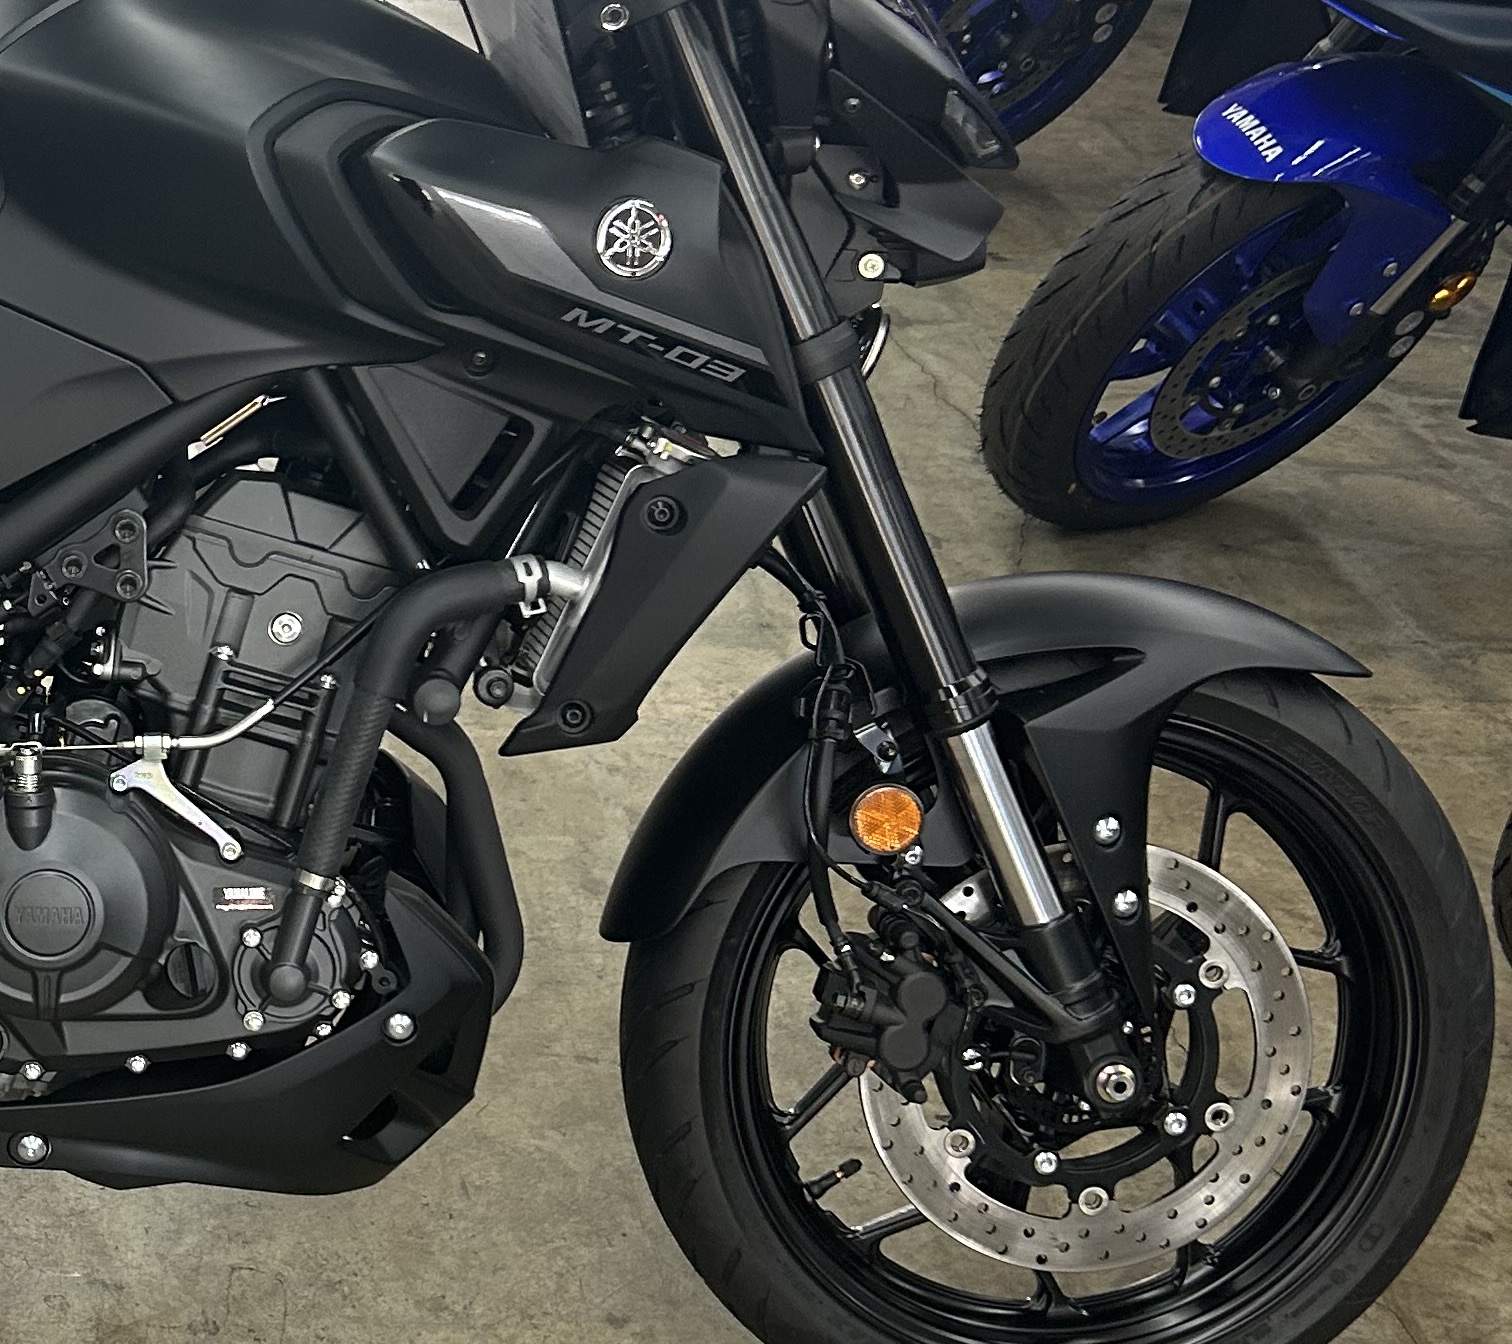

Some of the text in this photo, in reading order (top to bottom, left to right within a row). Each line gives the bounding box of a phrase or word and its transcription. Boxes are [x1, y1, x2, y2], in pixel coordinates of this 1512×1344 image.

[1221, 102, 1284, 163] YAMAHA
[560, 307, 747, 383] MT-03
[14, 906, 85, 926] YAMAHA
